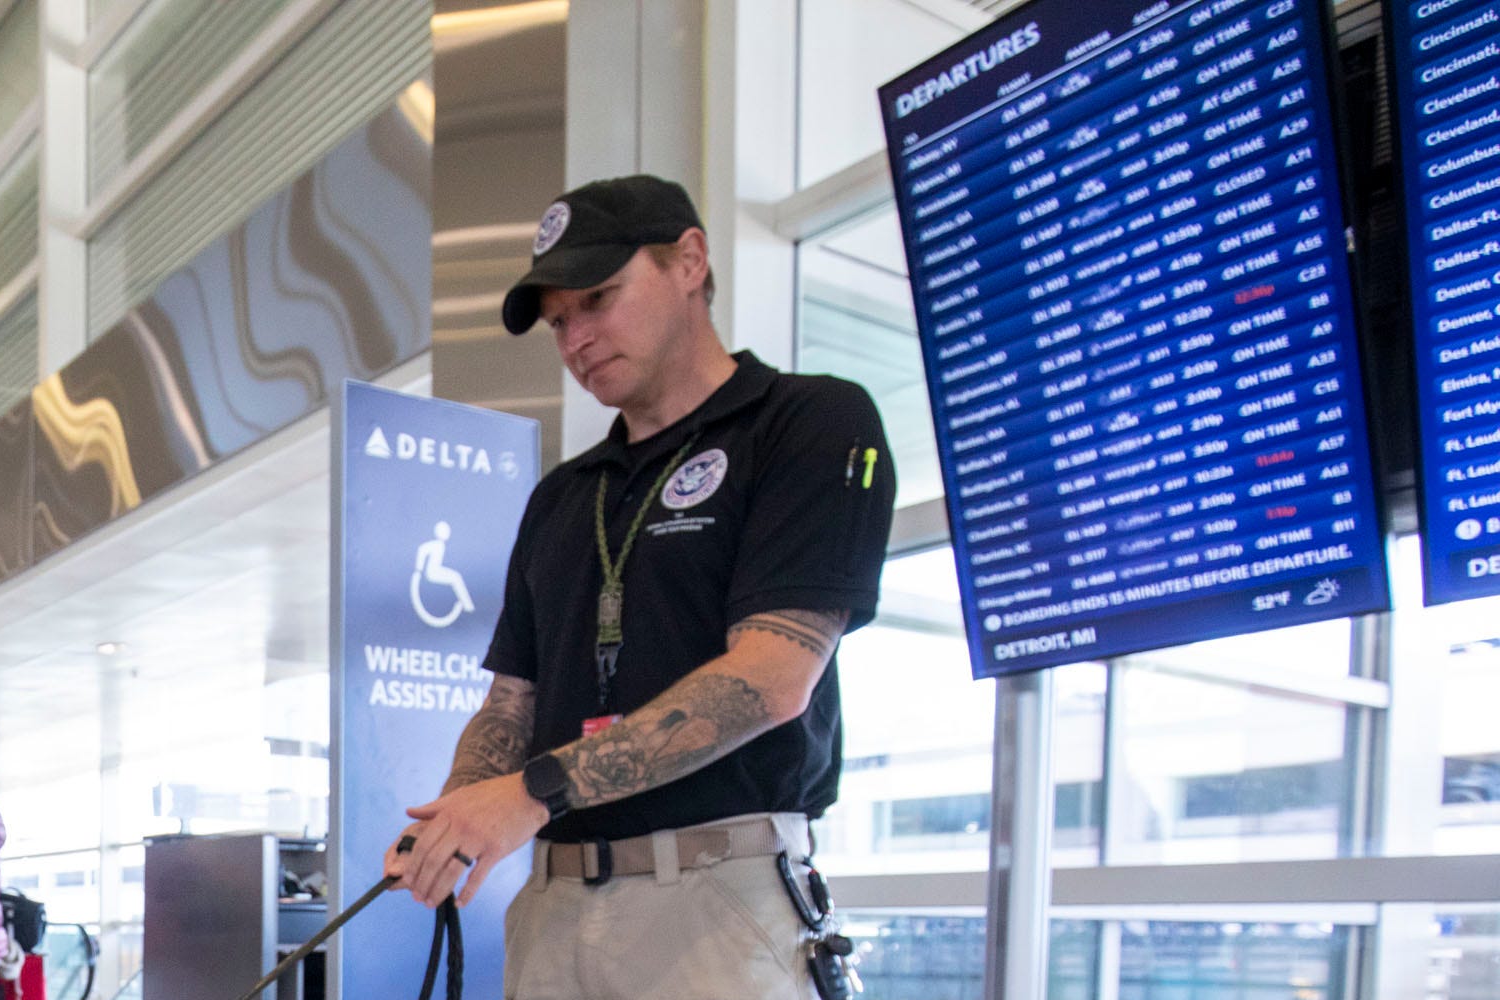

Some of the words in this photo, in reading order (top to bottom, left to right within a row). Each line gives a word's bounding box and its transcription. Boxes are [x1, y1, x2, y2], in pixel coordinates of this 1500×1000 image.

[1193, 36, 1216, 55] ON
[1214, 19, 1251, 43] TIME
[1419, 9, 1498, 51] Cincinnati,
[896, 22, 1040, 117] DEPARTURES
[1197, 65, 1219, 83] ON
[1218, 48, 1254, 76] TIME
[1202, 94, 1220, 111] AT
[1219, 78, 1257, 103] GATE
[1423, 75, 1500, 115] Cleveland,
[1204, 122, 1226, 140] ON
[1225, 107, 1261, 133] TIME
[1208, 151, 1230, 169] ON
[1228, 136, 1265, 162] TIME
[1215, 166, 1266, 195] CLOSED
[1215, 207, 1237, 224] ON
[1235, 193, 1272, 218] TIME
[1219, 235, 1240, 252] ON
[1239, 222, 1276, 246] TIME
[1222, 263, 1244, 280] ON
[1242, 250, 1279, 274] TIME
[1229, 319, 1251, 335] ON
[1249, 307, 1286, 329] TIME
[1233, 346, 1254, 362] ON
[1252, 335, 1289, 357] TIME
[1236, 374, 1258, 389] ON
[1256, 363, 1292, 384] TIME
[1240, 401, 1261, 416] ON
[1259, 390, 1296, 412] TIME
[1243, 428, 1264, 443] ON
[1262, 418, 1300, 439] TIME
[396, 432, 492, 475] DELTA
[1250, 482, 1271, 496] ON
[1269, 473, 1306, 492] TIME
[1255, 534, 1277, 549] ON
[1276, 527, 1312, 546] TIME
[1001, 602, 1072, 627] BOARDING
[1070, 594, 1109, 613] ENDS
[1108, 591, 1125, 605] 15
[1124, 576, 1192, 602] MINUTES
[1190, 564, 1250, 589] BEFORE
[1250, 544, 1352, 576] DEPARTURE.
[995, 632, 1071, 660] DETROIT,
[1071, 627, 1096, 645] MI
